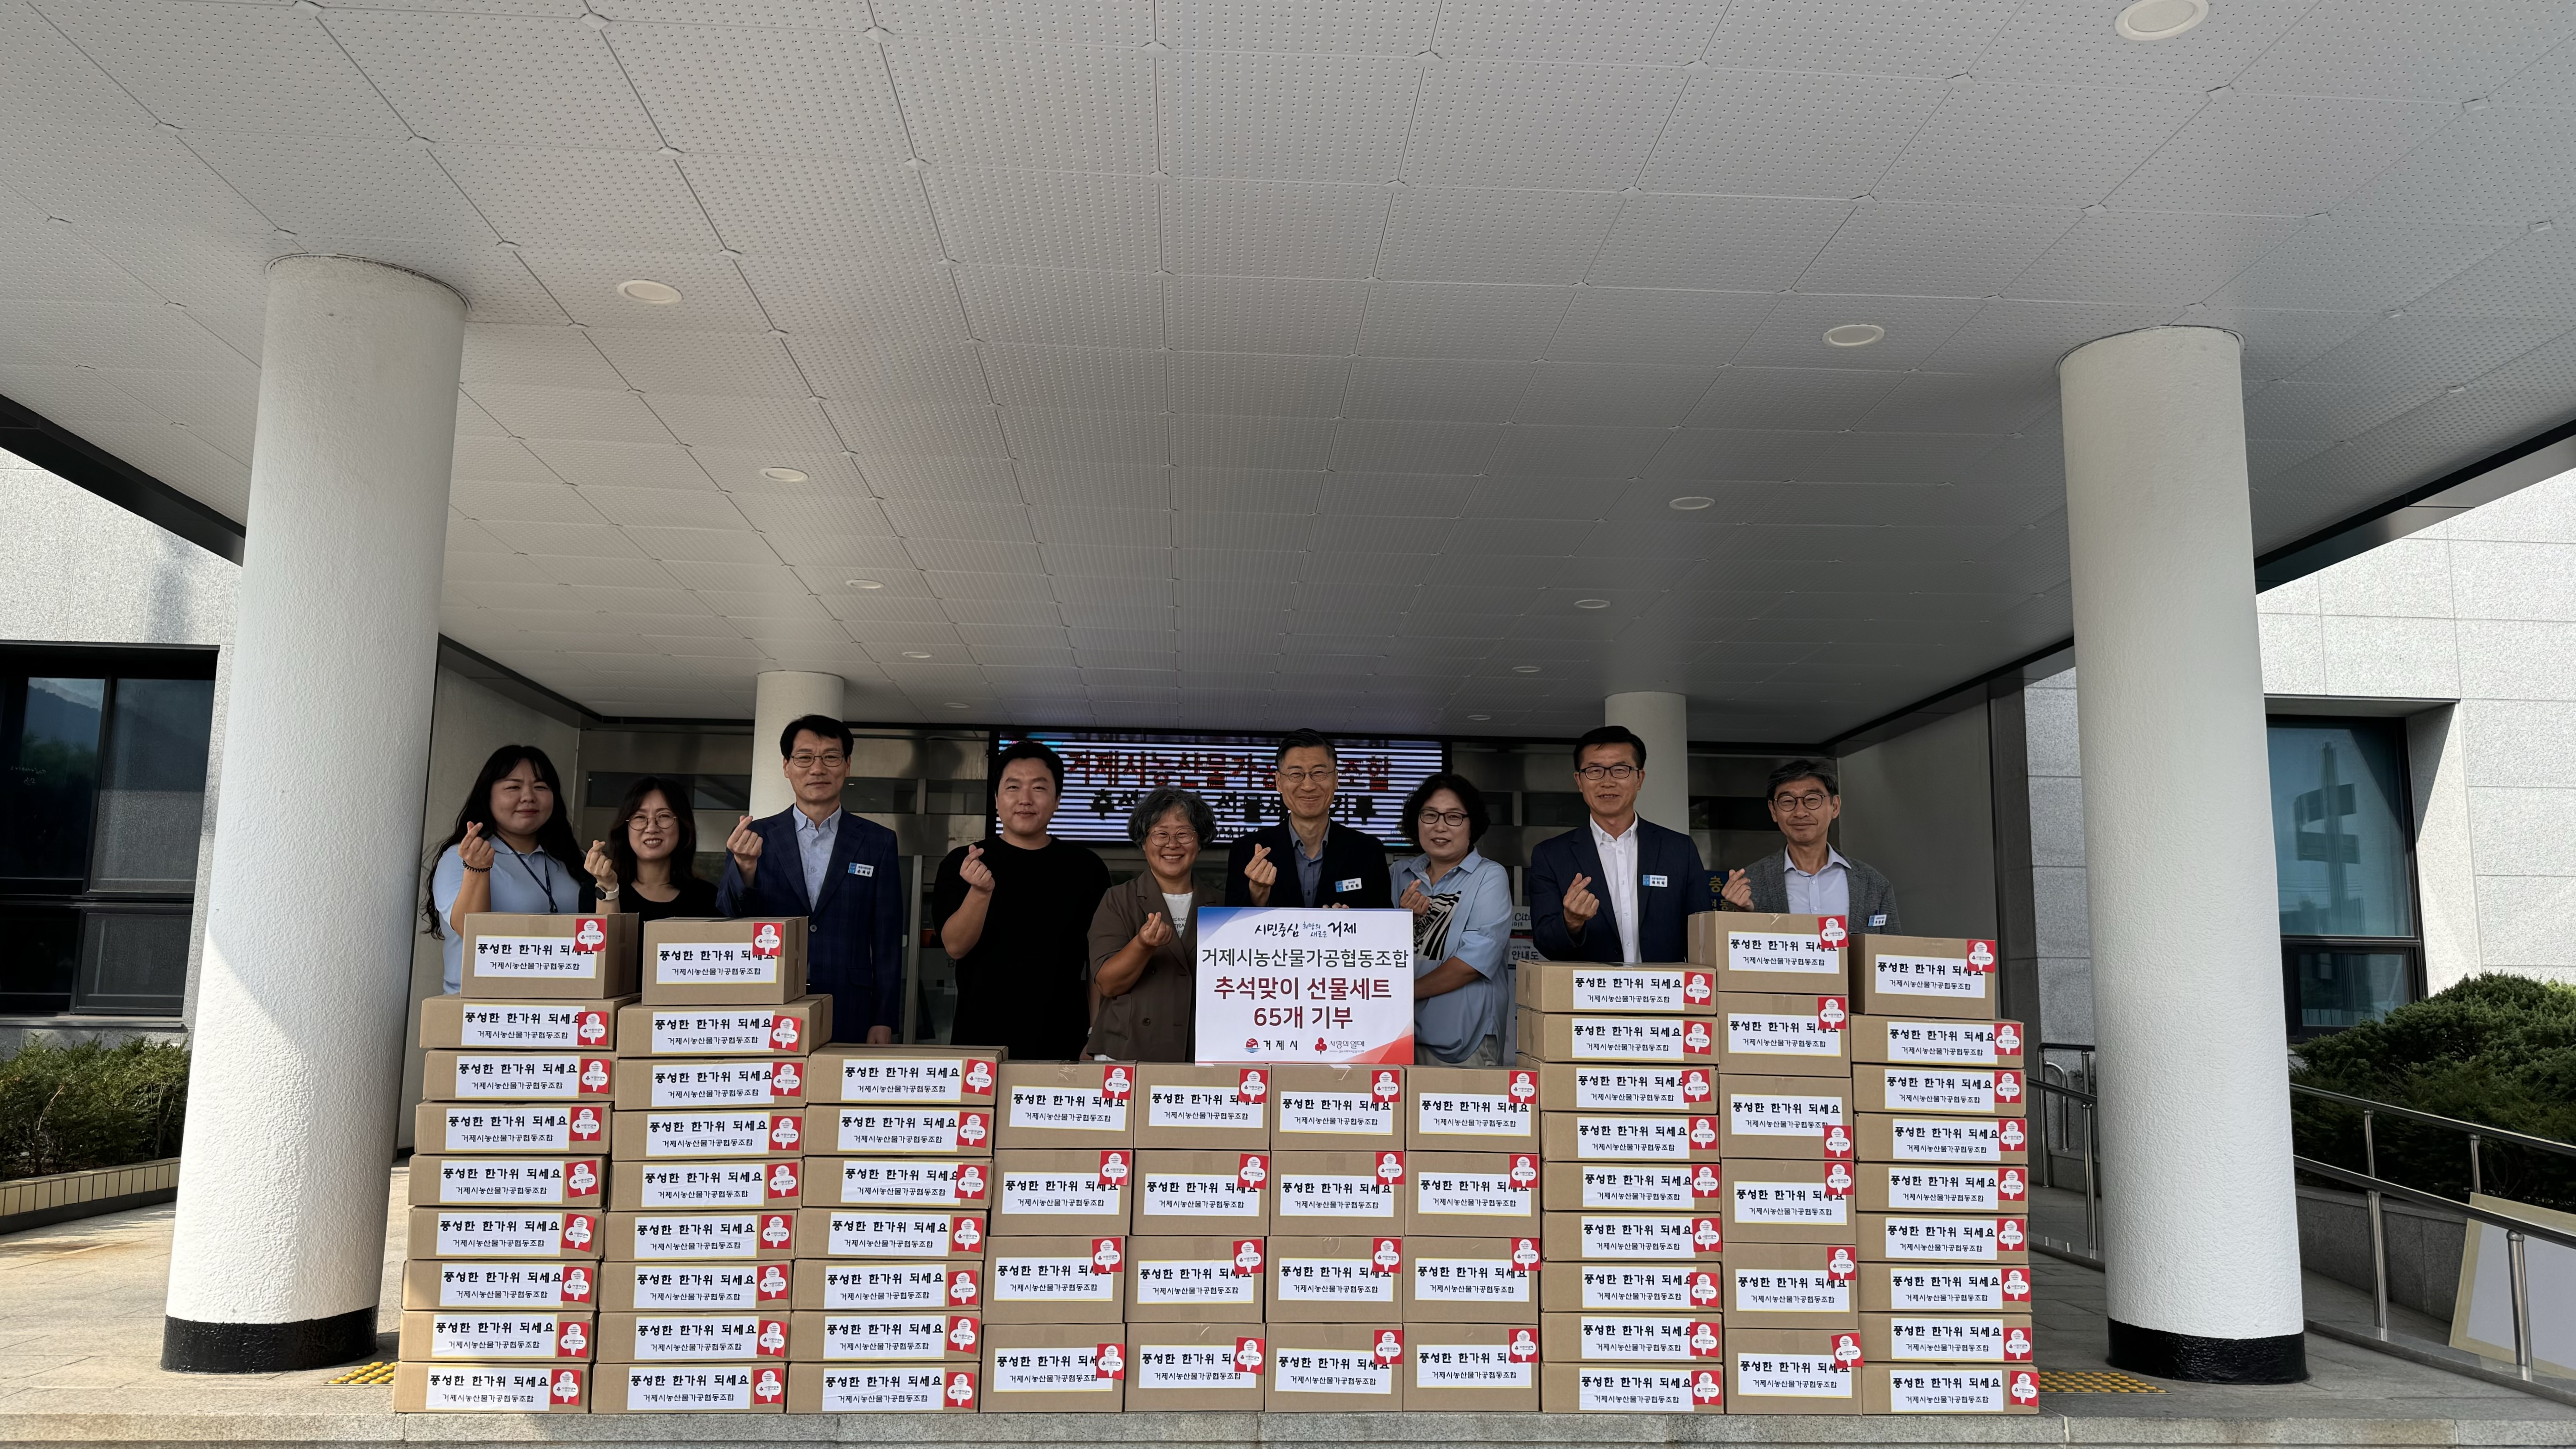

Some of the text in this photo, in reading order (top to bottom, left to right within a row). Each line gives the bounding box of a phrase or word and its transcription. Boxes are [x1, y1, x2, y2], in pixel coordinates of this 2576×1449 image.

[1255, 923, 1299, 937] 시민중심
[1327, 921, 1356, 937] 거제
[477, 943, 552, 955] 풍성한 한가위
[1730, 939, 1798, 952] 풍성한 한가위
[659, 950, 733, 961] 풍성한 한가위
[1202, 948, 1409, 968] 거제시농산물가공협동조합
[1512, 950, 1539, 960] 안내도
[490, 962, 580, 970] 거제시농산물가공협동조합
[1743, 957, 1825, 966] 거제시농산물가공협동조합
[1878, 962, 1945, 975] 풍성한 한가위
[1214, 976, 1392, 1000] 추석맞이 선물세트
[1575, 978, 1682, 989] 풍성한 한가위 되세요
[1890, 979, 1971, 991] 거제시농산물가공협동조합
[1254, 1006, 1353, 1029] 65개 기부
[1574, 1025, 1681, 1037] 풍성한 한가위 되세요
[1586, 1043, 1669, 1051] 거제시농산물가공협동조합
[845, 1067, 960, 1078] 풍성한 한가위 되세요
[1887, 1076, 1992, 1090] 풍성한 한가위 되세요
[1013, 1094, 1124, 1108] 풍성한 한가위 되세요
[1152, 1093, 1222, 1106] 풍성한 한가위
[1899, 1094, 1980, 1104] 거제시농산물가공협동조합
[1282, 1099, 1390, 1112] 풍성한 한가위 되세요
[1421, 1100, 1529, 1113] 풍성한 한가위 되세요
[448, 1116, 483, 1127] 풍성한
[490, 1116, 525, 1127] 한가위
[532, 1116, 567, 1127] 되세요
[1025, 1112, 1110, 1122] 거제시농산물가공협동조합
[1164, 1112, 1248, 1120] 거제시농산물가공협동조합
[1294, 1117, 1377, 1125] 거제시농산물가공협동조합
[649, 1122, 684, 1133] 풍성한
[691, 1121, 725, 1132] 한가위
[732, 1120, 768, 1131] 되세요
[1434, 1119, 1516, 1127] 거제시농산물가공협동조합
[1579, 1125, 1688, 1137] 풍성한 한가위 되세요
[662, 1139, 753, 1148] 거제시농산물가공협동조합
[1592, 1143, 1675, 1151] 거제시농산물가공협동조합
[1005, 1180, 1039, 1191] 풍성한
[1045, 1181, 1078, 1192] 한가위
[1421, 1180, 1490, 1192] 풍성한 한가위
[1585, 1174, 1693, 1187] 풍성한 한가위 되세요
[1891, 1175, 1997, 1188] 풍성한 한가위 되세요
[1147, 1182, 1180, 1193] 풍성한
[1186, 1182, 1218, 1194] 한가위
[1282, 1182, 1391, 1195] 풍성한 한가위 되세요
[1597, 1192, 1680, 1201] 거제시농산물가공협동조합
[1736, 1189, 1768, 1200] 풍성한
[1774, 1190, 1805, 1201] 한가위
[1903, 1193, 1984, 1202] 거제시농산물가공협동조합
[1159, 1200, 1244, 1208] 거제시농산물가공협동조합
[1433, 1198, 1516, 1207] 거제시농산물가공협동조합
[1749, 1208, 1832, 1216] 거제시농산물가공협동조합
[440, 1220, 560, 1232] 풍성한 한가위 되세요
[832, 1220, 948, 1233] 풍성한 한가위 되세요
[844, 1239, 933, 1248] 거제시농산물가공협동조합
[1140, 1268, 1212, 1280] 풍성한 한가위
[1417, 1266, 1527, 1279] 풍성한 한가위 되세요
[1738, 1277, 1847, 1289] 풍성한 한가위 되세요
[1153, 1287, 1238, 1295] 거제시농산물가공협동조합
[1430, 1285, 1514, 1293] 거제시농산물가공협동조합
[1751, 1295, 1834, 1303] 거제시농산물가공협동조합
[637, 1324, 756, 1336] 풍성한 한가위 되세요
[651, 1343, 742, 1352] 거제시농산물가공협동조합
[996, 1356, 1070, 1367] 풍성한 한가위
[1278, 1356, 1312, 1368] 풍성한
[1318, 1358, 1350, 1370] 한가위
[430, 1375, 549, 1387] 풍성한 한가위 되세요
[630, 1375, 749, 1386] 풍성한 한가위 되세요
[825, 1376, 942, 1388] 풍성한 한가위 되세요
[1009, 1374, 1097, 1383] 거제시농산물가공협동조합
[1291, 1376, 1376, 1385] 거제시농산물가공협동조합
[1893, 1378, 2001, 1389] 풍성한 한가위 되세요
[443, 1394, 534, 1403] 거제시농산물가공협동조합
[643, 1394, 734, 1402] 거제시농산물가공협동조합
[838, 1395, 927, 1403] 거제시농산물가공협동조합
